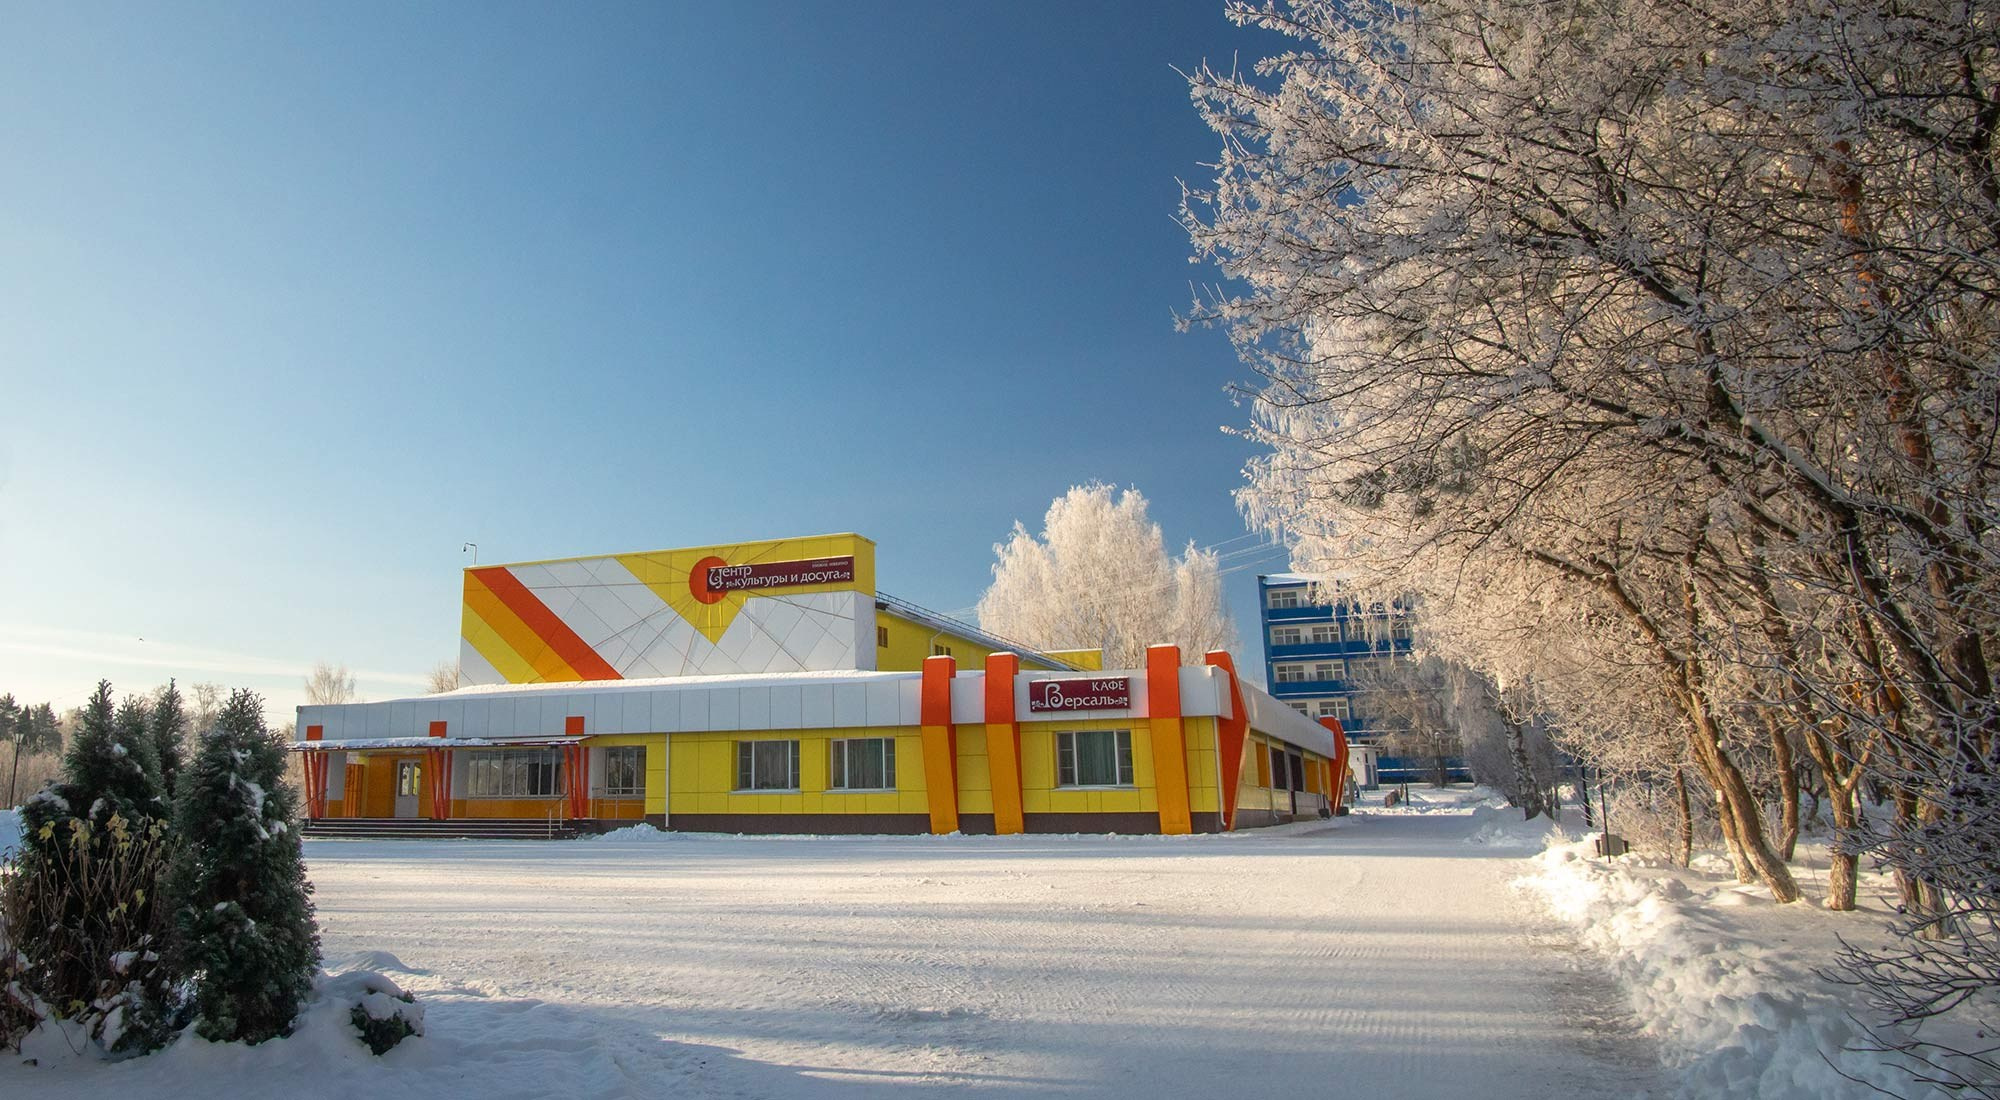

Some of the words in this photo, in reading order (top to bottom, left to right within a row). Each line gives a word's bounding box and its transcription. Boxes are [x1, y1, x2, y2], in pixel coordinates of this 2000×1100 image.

[709, 566, 752, 589] Центр
[735, 573, 788, 589] культуры
[790, 573, 798, 583] и
[800, 570, 840, 583] досуга
[1045, 682, 1115, 710] Версаль
[1092, 680, 1126, 692] КАФЕ
